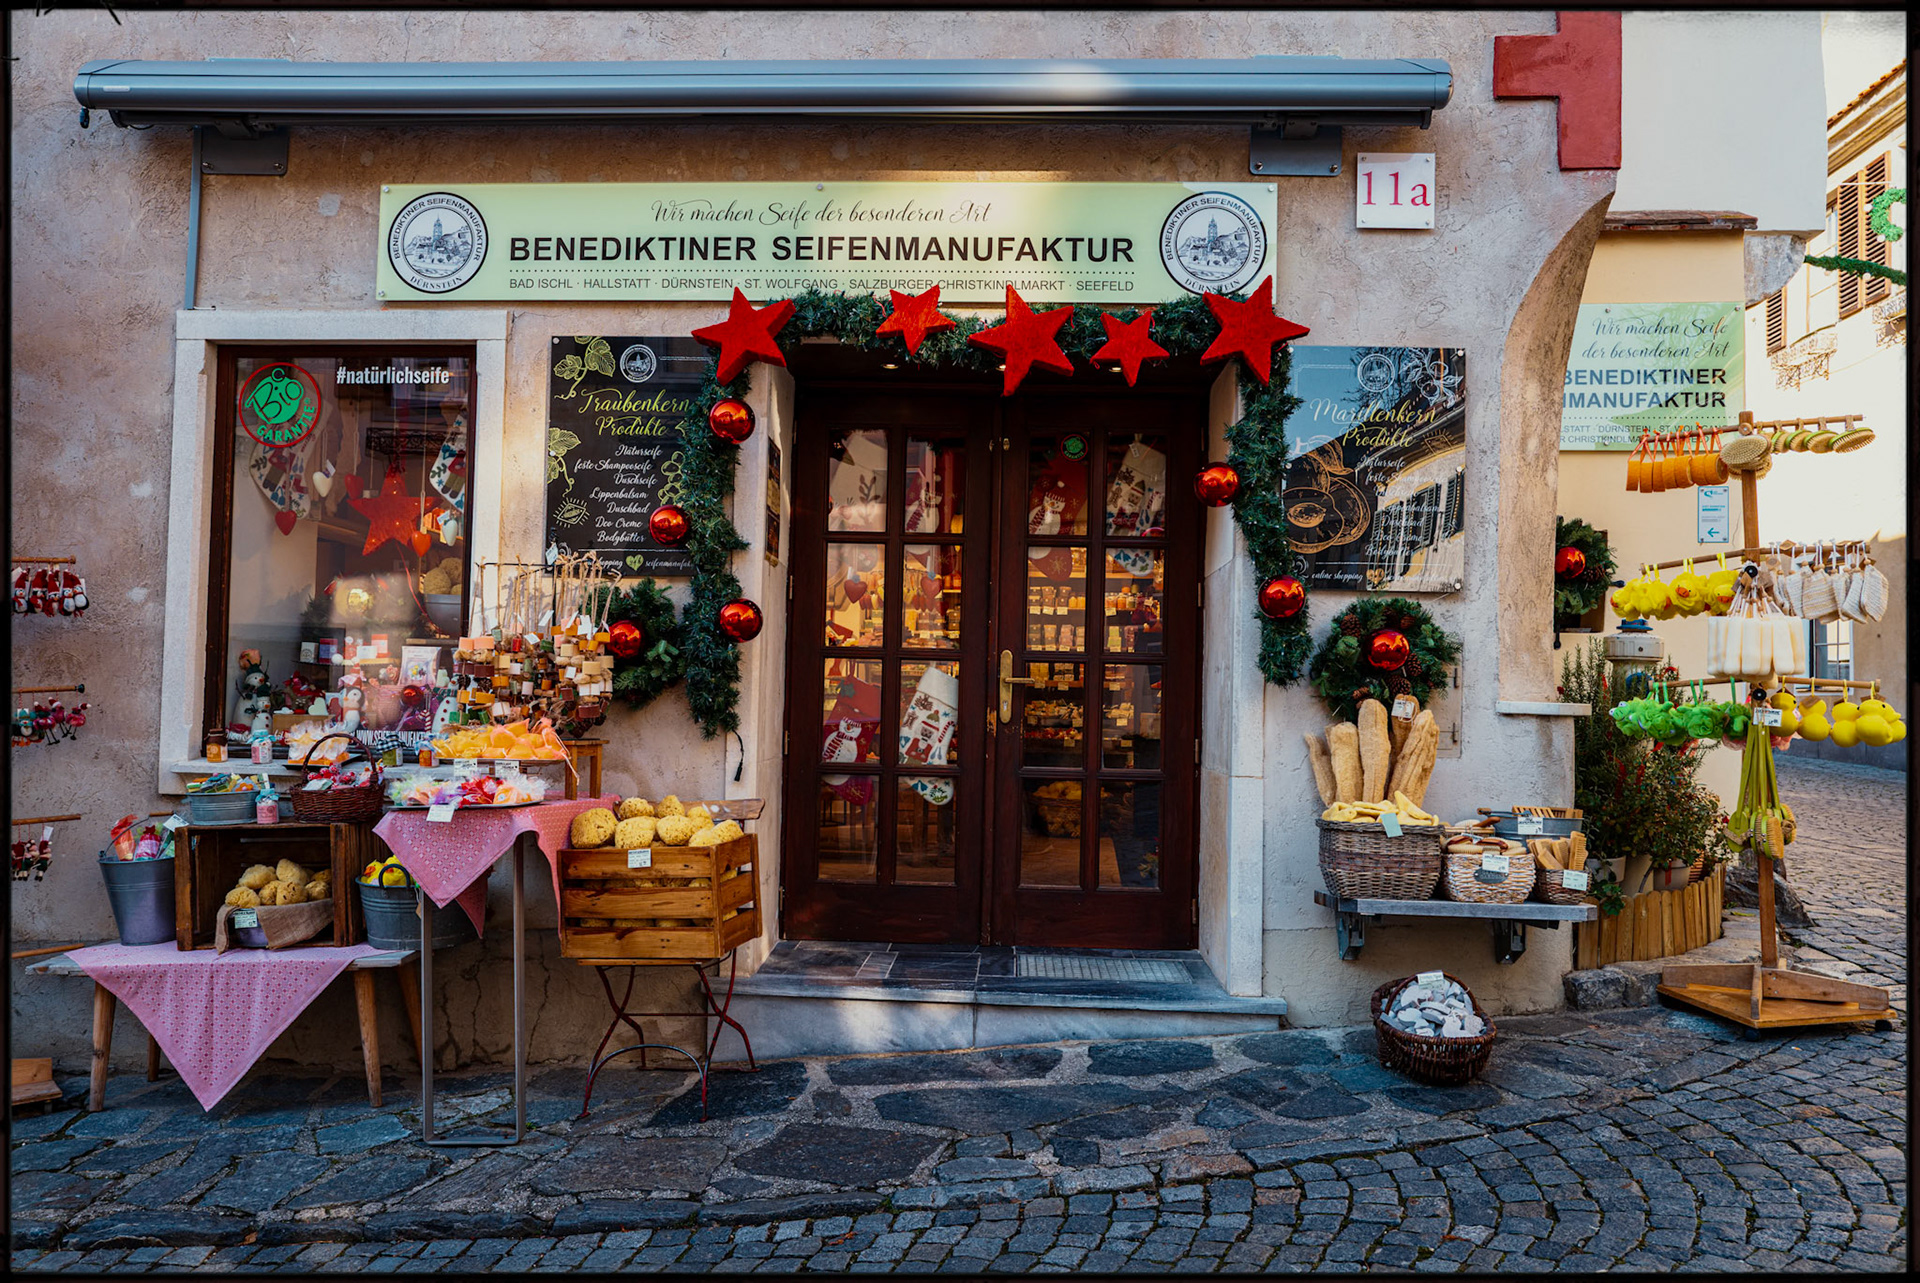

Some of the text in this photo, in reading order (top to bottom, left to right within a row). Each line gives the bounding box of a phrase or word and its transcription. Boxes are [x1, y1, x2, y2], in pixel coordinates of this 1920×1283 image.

[1361, 170, 1432, 207] 11a
[651, 199, 992, 229] Wir machen Seife der besonderen Art
[393, 197, 484, 261] BENEDIKTINER SEIFENMANUFAKTUR
[1165, 197, 1262, 264] BENEDIKTINER SEIFENMANUFAKTUR
[509, 235, 1135, 263] BENEDIKTINER SEIFENMANUFAKTUR
[410, 275, 463, 290] DÜRNSTEIN
[509, 278, 535, 289] BAD
[537, 278, 573, 289] ISCHL
[583, 278, 652, 289] HALLSTATT
[661, 276, 734, 290] DÜRNSTEIN
[744, 278, 762, 289] ST.
[765, 278, 838, 290] WOLFGANG
[849, 278, 934, 291] SALZBURGER
[1076, 280, 1135, 292] SEEFELD
[1592, 315, 1729, 342] Wir machen Seife
[1581, 340, 1731, 359] der besonderen Art
[336, 365, 450, 385] #natürlichseife
[578, 388, 690, 414] Traubenkern
[1563, 392, 1727, 408] MANUFAKTUR
[1309, 398, 1437, 425] Marillenkern
[595, 415, 670, 437] Produkte
[1599, 423, 1651, 433] DÜRNSTEIN
[1340, 423, 1415, 448] Produkte
[614, 444, 663, 460] Naturseife
[574, 458, 653, 474] feste Shampooseife
[613, 472, 658, 488] Duschseife
[589, 486, 649, 501] Lippenbalsam
[606, 502, 651, 514] Duschbad
[595, 515, 644, 528] Deo Creme
[596, 531, 647, 546] Bodybutter
[1334, 569, 1363, 583] shopping
